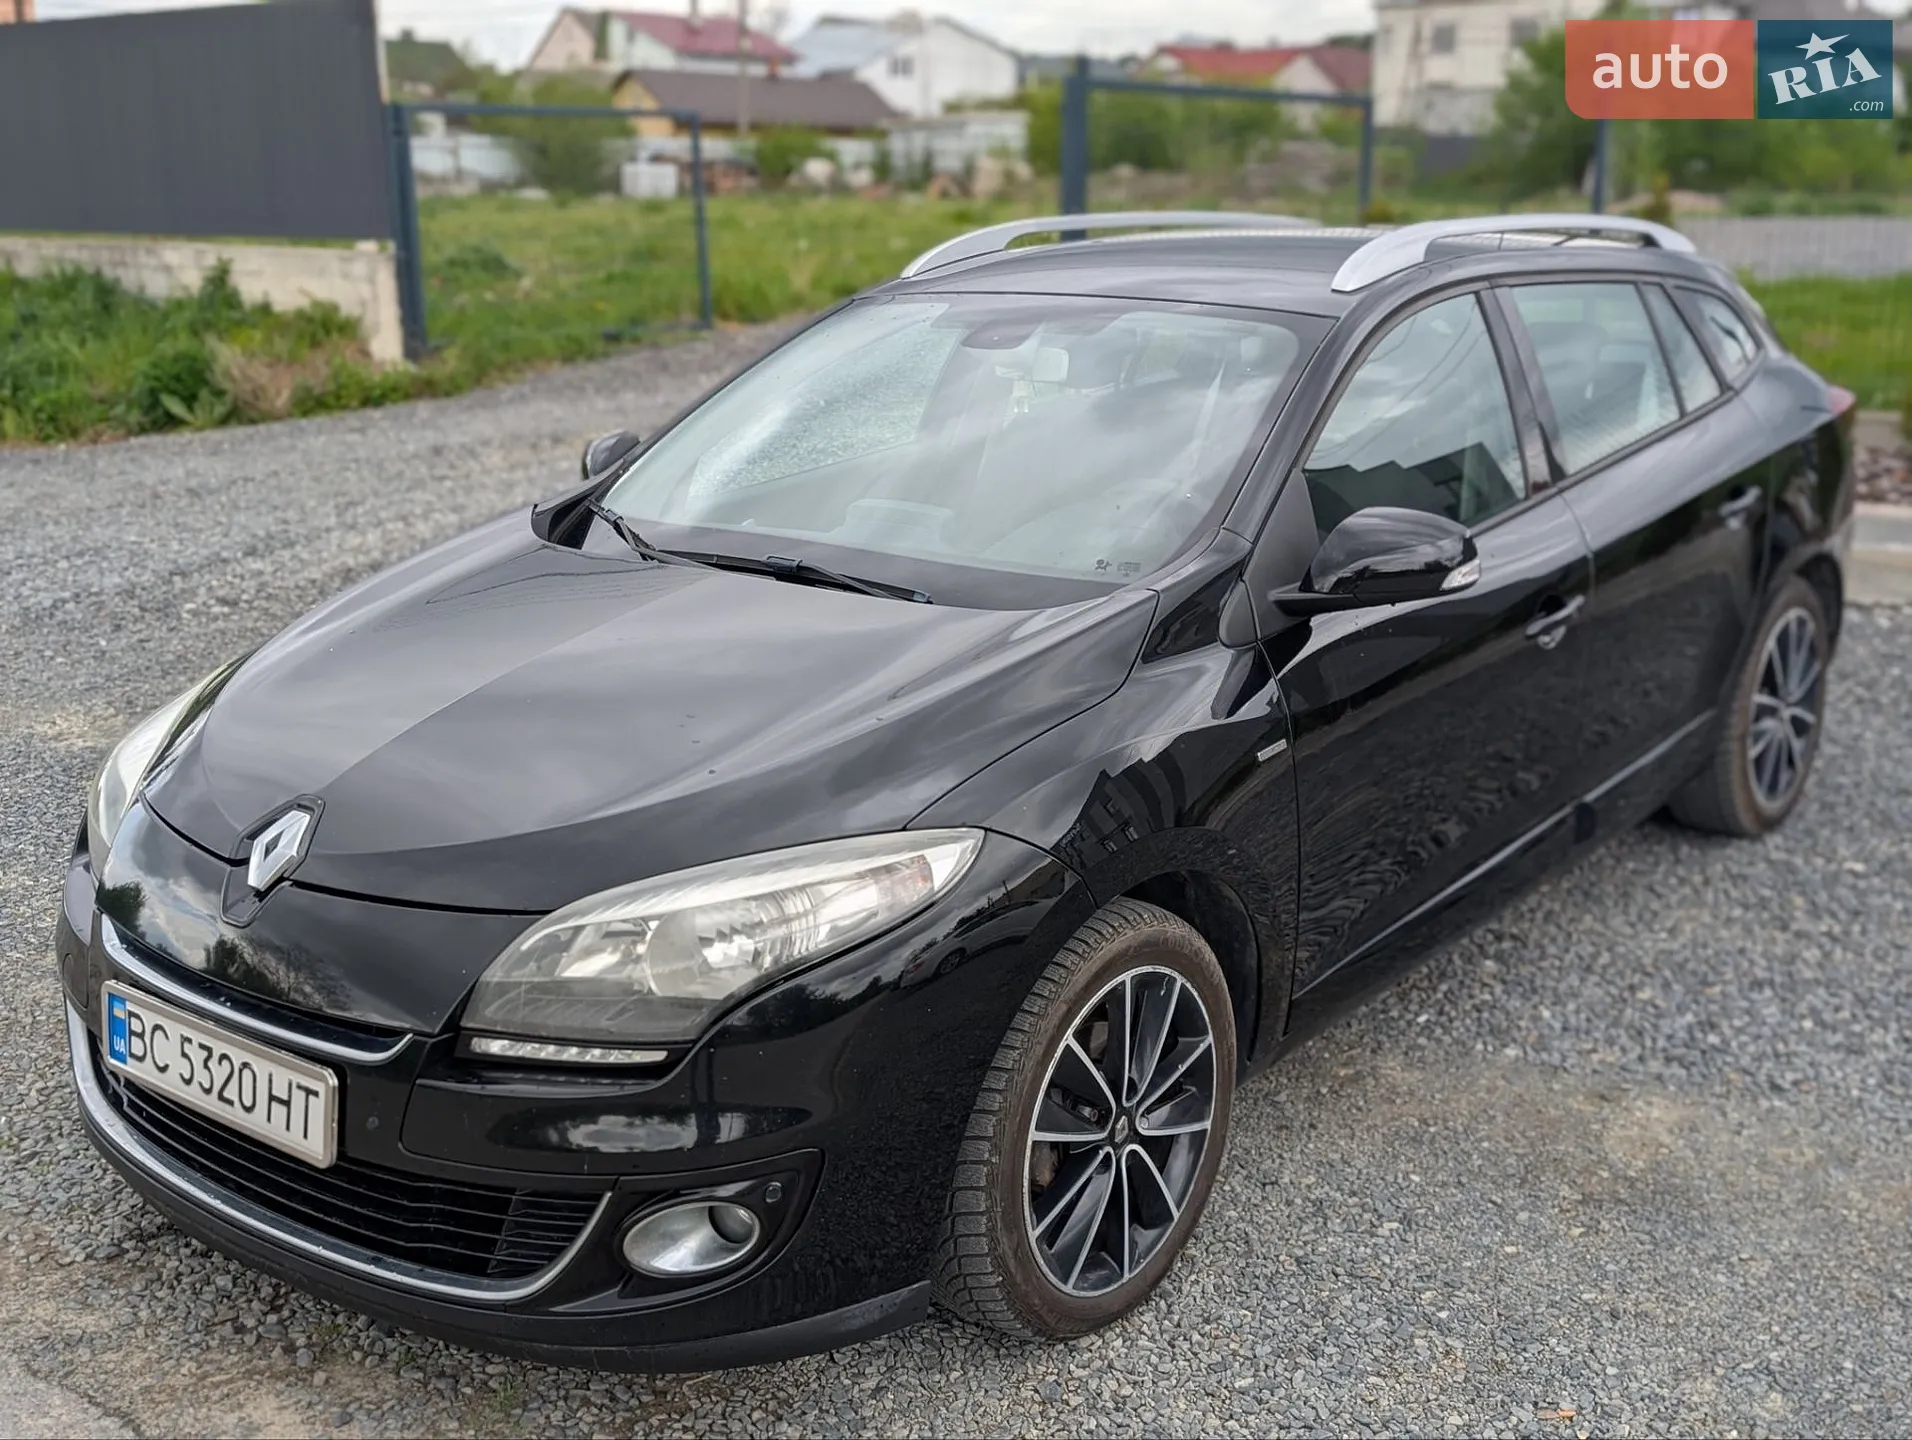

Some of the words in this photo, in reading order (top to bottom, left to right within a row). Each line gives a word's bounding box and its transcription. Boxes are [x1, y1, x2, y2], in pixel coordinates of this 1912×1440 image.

[113, 1036, 126, 1055] UA
[127, 1009, 170, 1073] BC
[179, 1033, 258, 1114] 5320
[266, 1073, 320, 1140] HT
